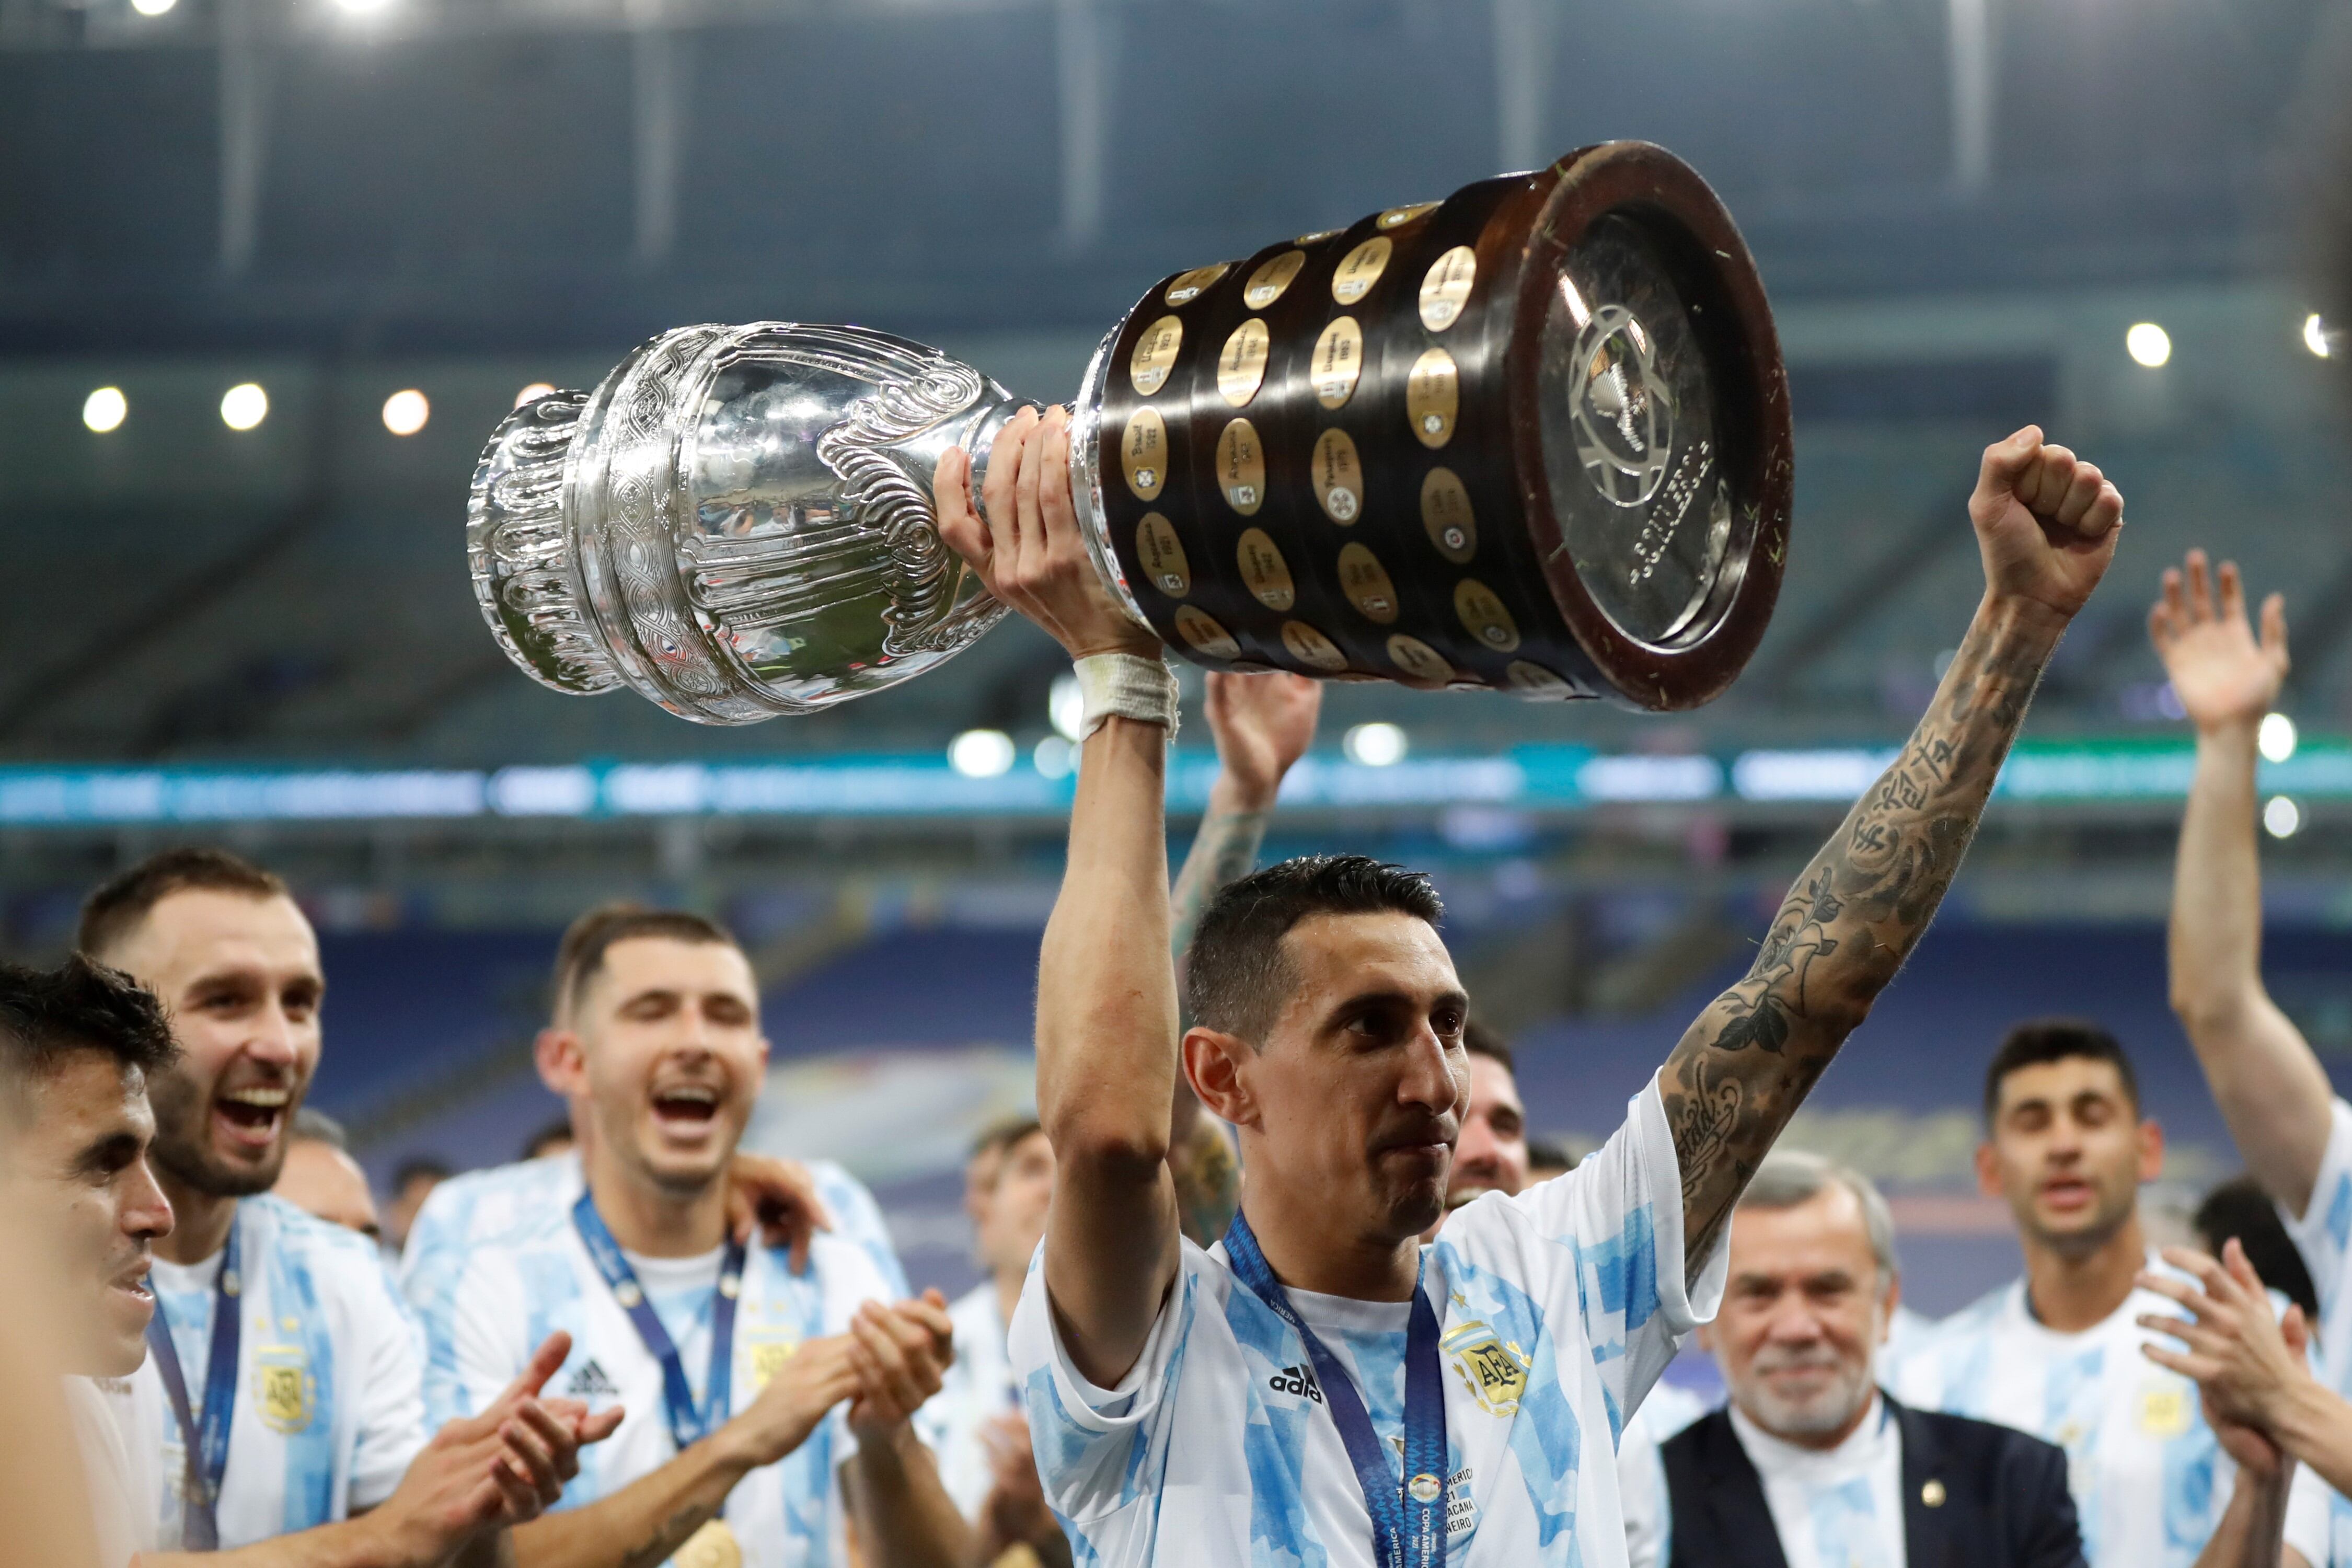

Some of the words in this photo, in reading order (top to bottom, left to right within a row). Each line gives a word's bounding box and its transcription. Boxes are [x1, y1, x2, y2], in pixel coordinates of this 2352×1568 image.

[1132, 424, 1143, 456] Brasil
[1270, 1298, 1296, 1324] MERICA
[1469, 1344, 1520, 1387] AFA
[1446, 1468, 1473, 1487] MERIC
[1446, 1490, 1456, 1503] 21
[1446, 1500, 1474, 1519] ACANA
[1422, 1508, 1431, 1534] COPA
[1446, 1517, 1472, 1535] NEIRO
